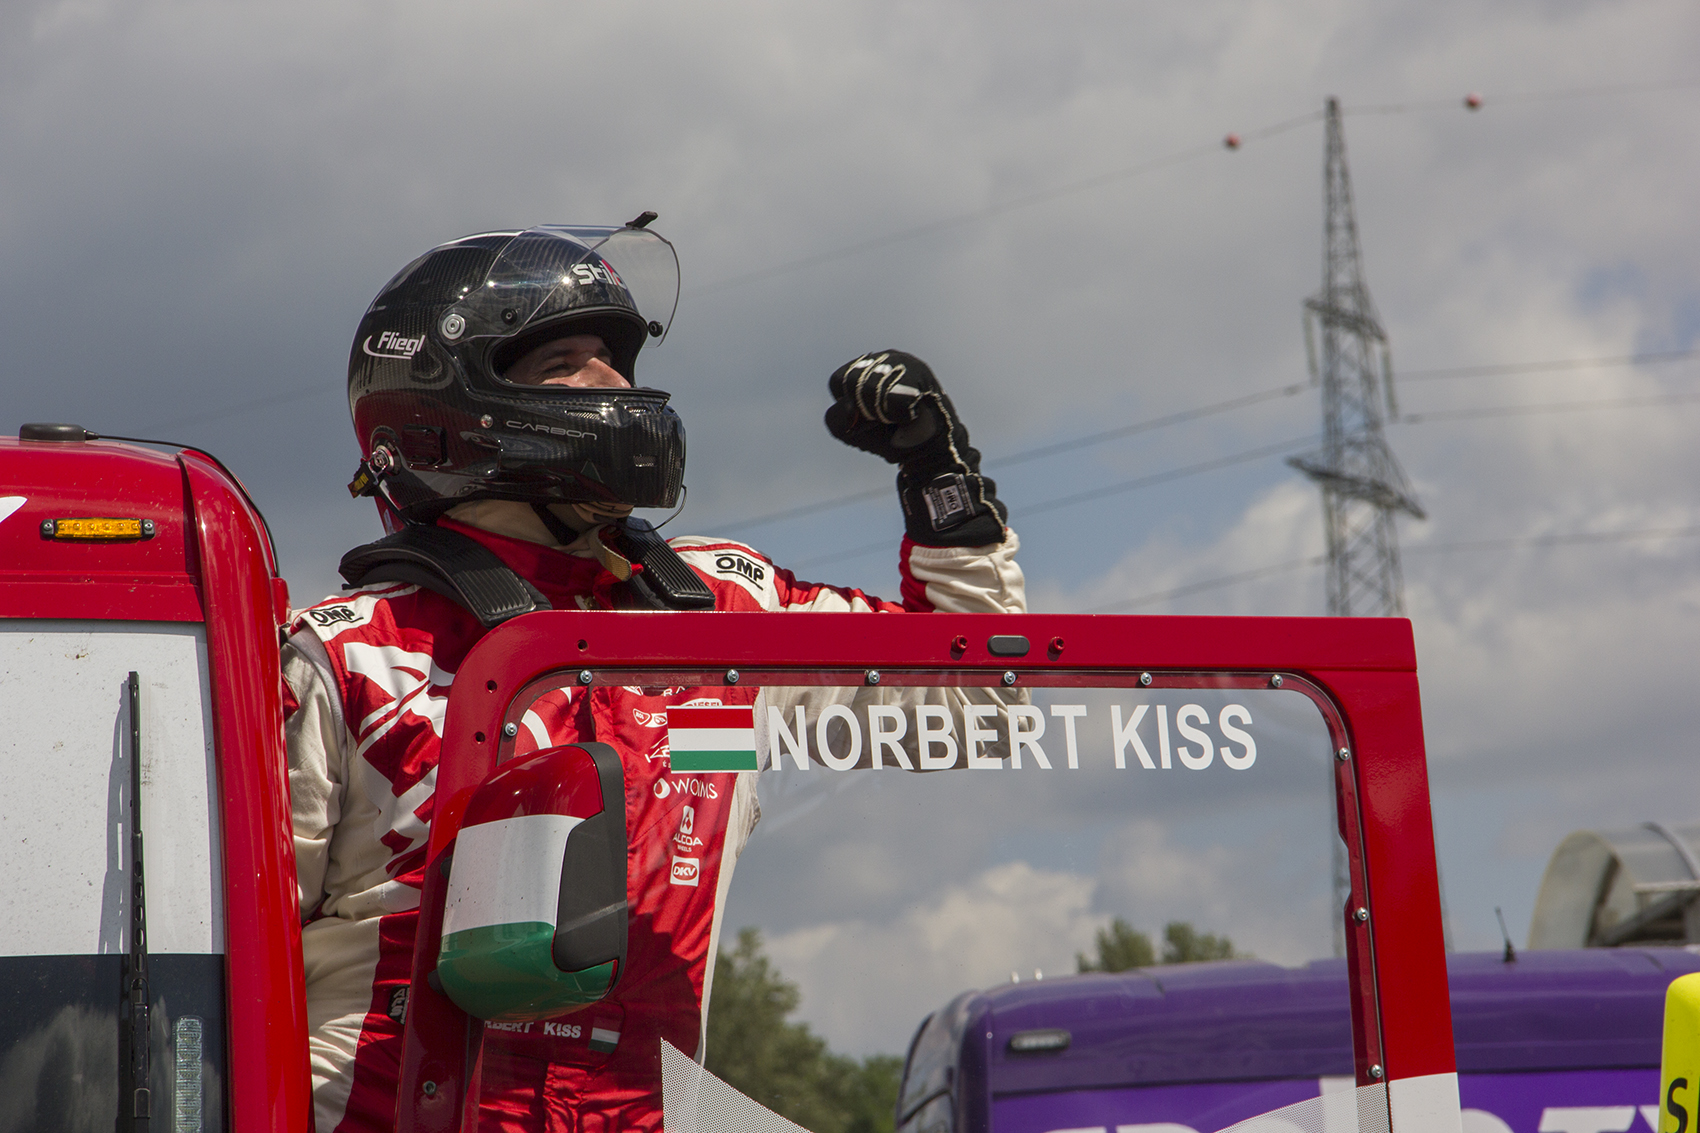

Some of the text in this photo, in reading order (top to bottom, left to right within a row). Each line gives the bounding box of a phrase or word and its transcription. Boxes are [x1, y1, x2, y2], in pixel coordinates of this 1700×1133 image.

[377, 331, 425, 356] Fliegl
[506, 420, 597, 440] CARBON
[715, 556, 765, 582] OMP
[309, 607, 356, 623] OMP
[768, 703, 1258, 772] NORBERT KISS
[673, 832, 703, 846] ALCOA
[673, 865, 696, 877] DKV
[543, 1021, 582, 1039] KISS
